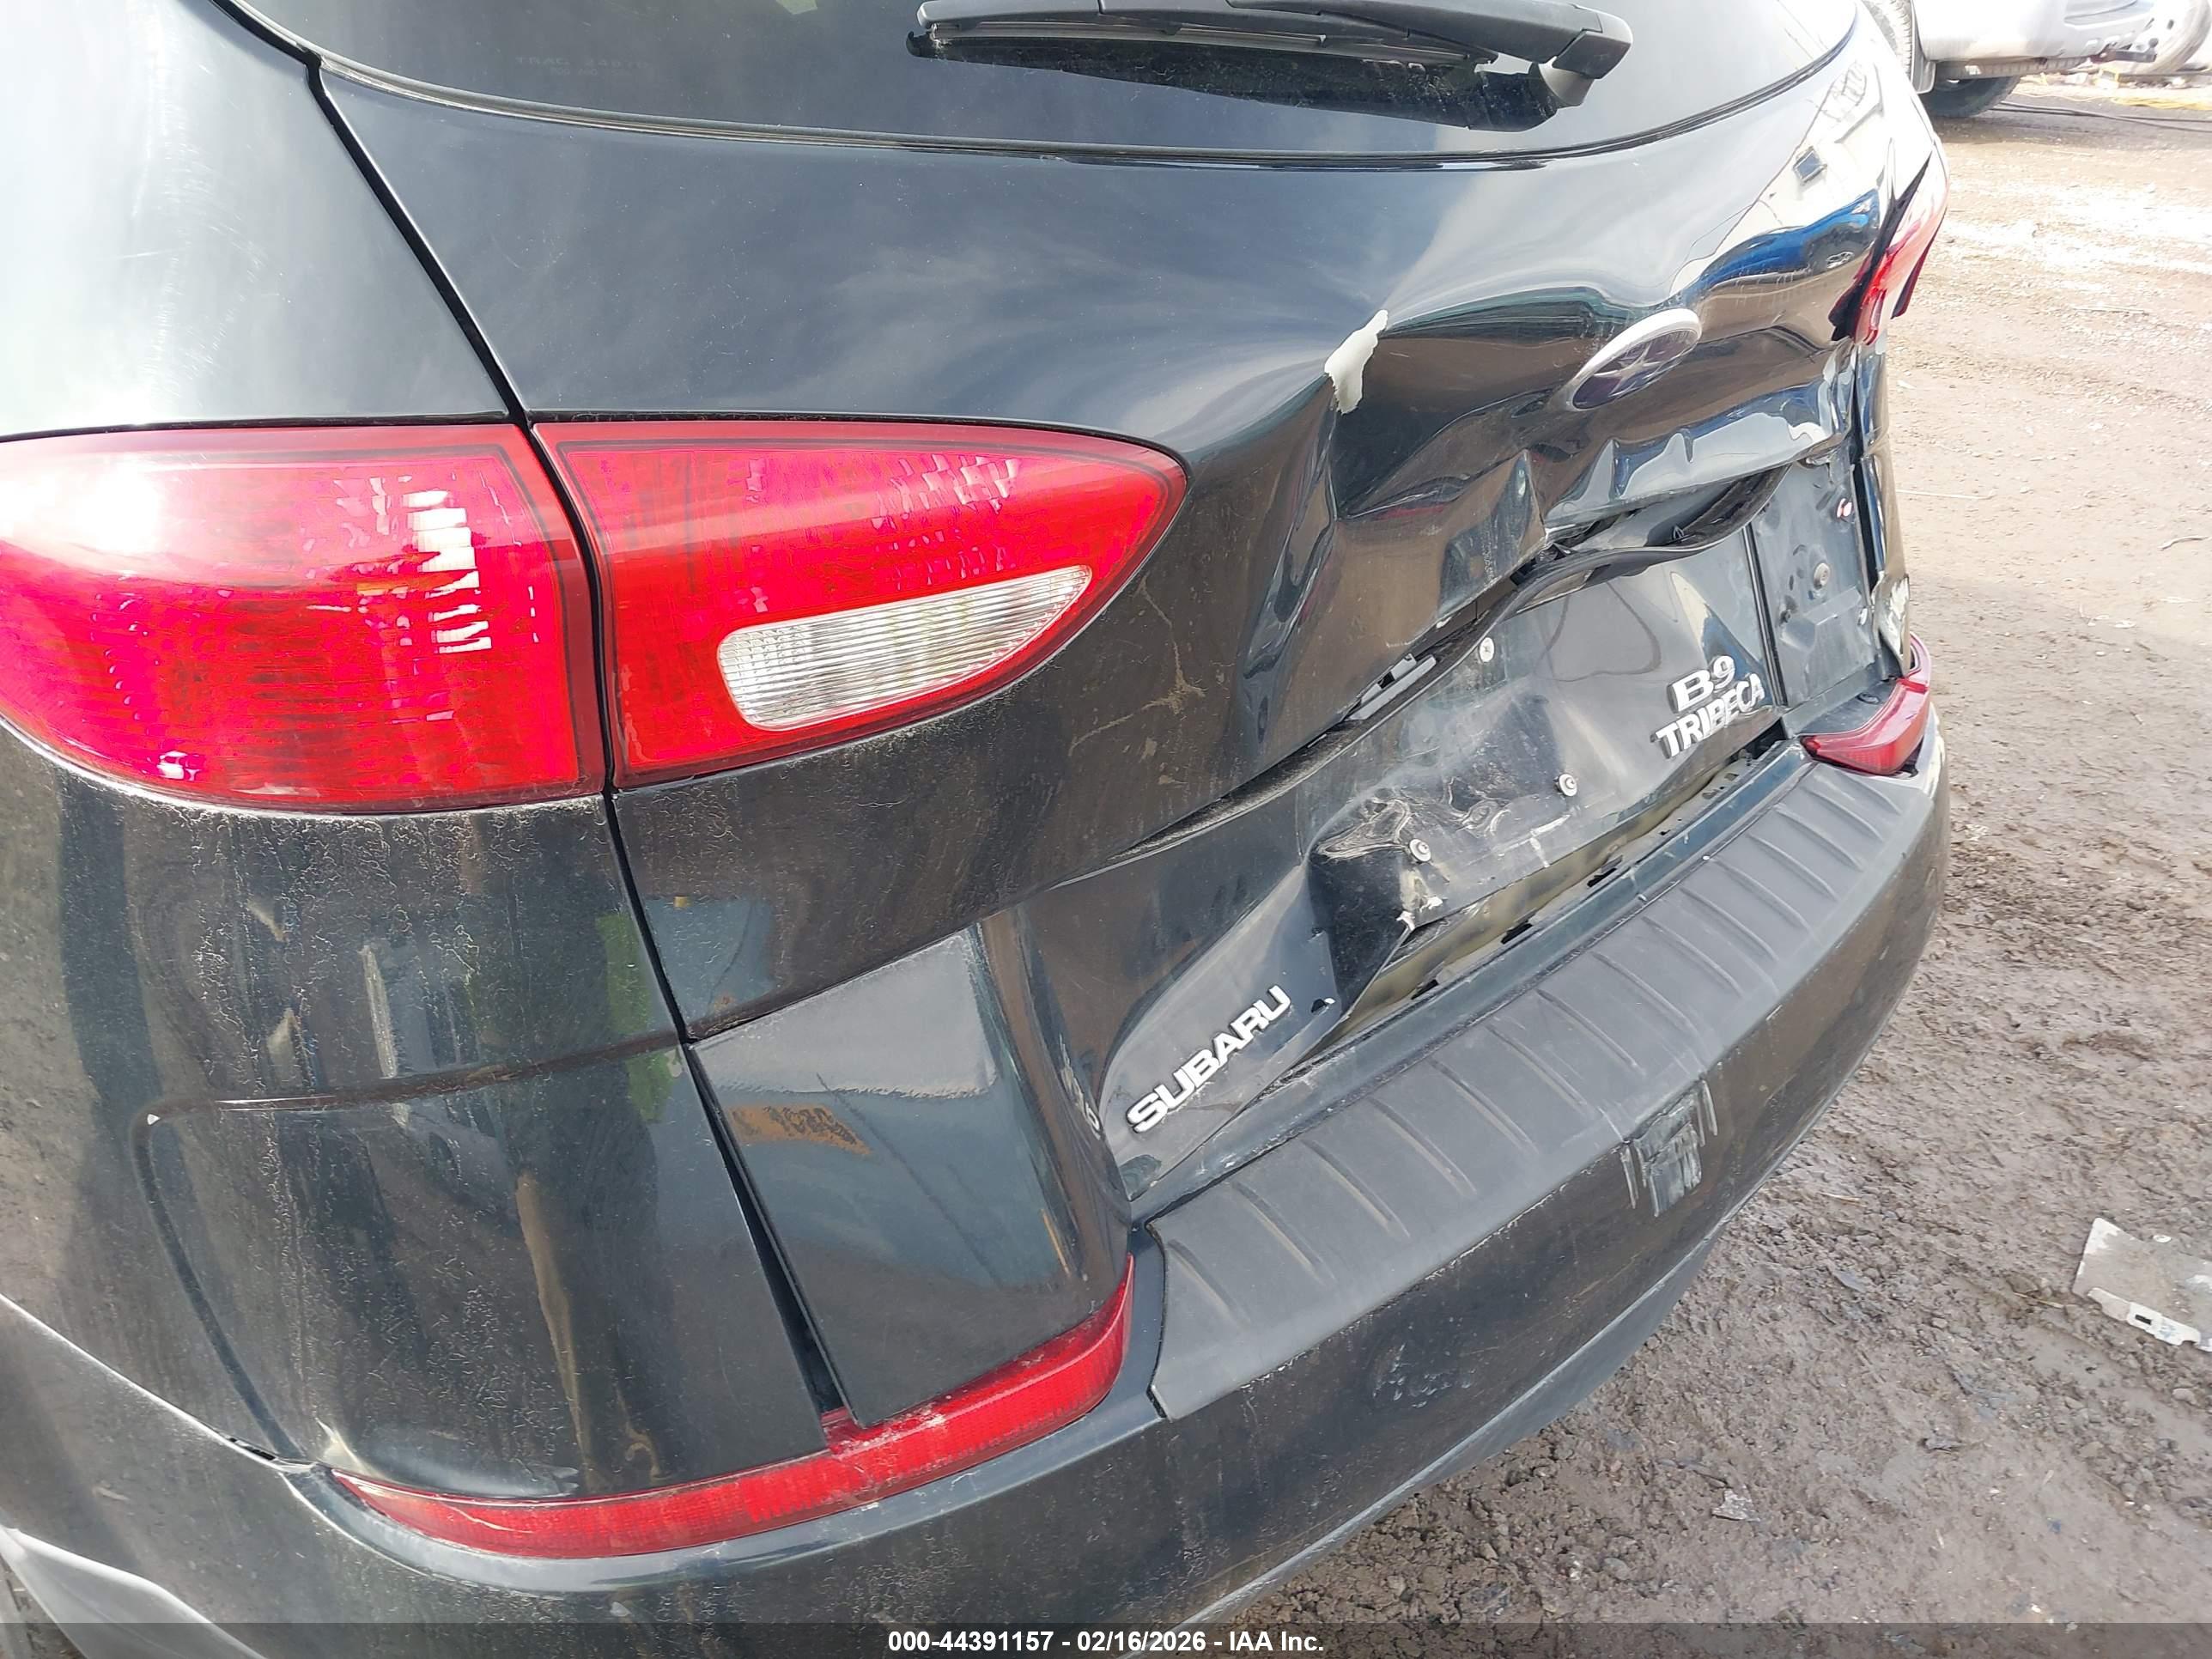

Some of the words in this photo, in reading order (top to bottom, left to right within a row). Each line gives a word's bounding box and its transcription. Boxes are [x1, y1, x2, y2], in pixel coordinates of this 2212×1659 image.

[1651, 673, 1765, 758] TRIBECA
[1668, 655, 1735, 713] B9
[1126, 985, 1291, 1133] SUBARU
